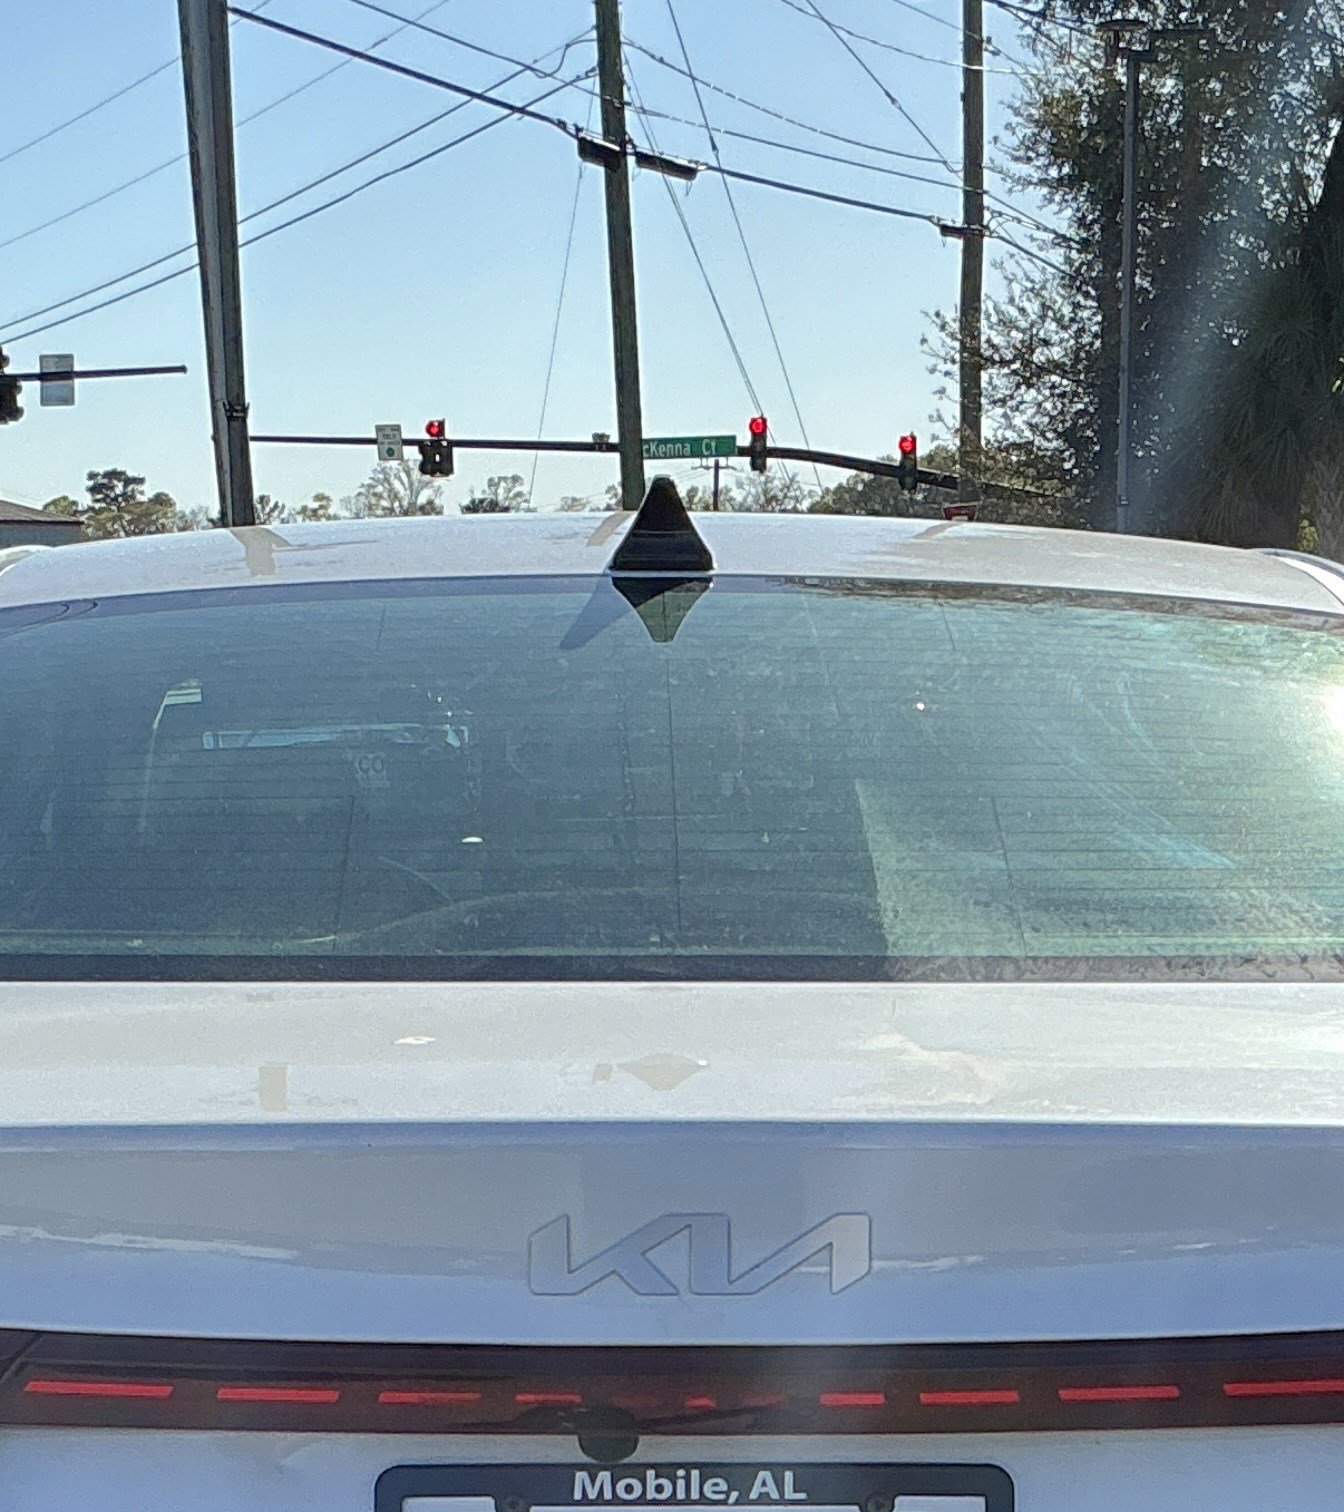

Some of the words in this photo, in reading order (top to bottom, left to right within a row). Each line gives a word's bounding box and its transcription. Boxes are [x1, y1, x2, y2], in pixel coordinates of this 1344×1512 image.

[642, 441, 691, 458] cKenna
[528, 1212, 872, 1296] KIA
[573, 1469, 739, 1503] Mobile,
[749, 1470, 808, 1500] AL
